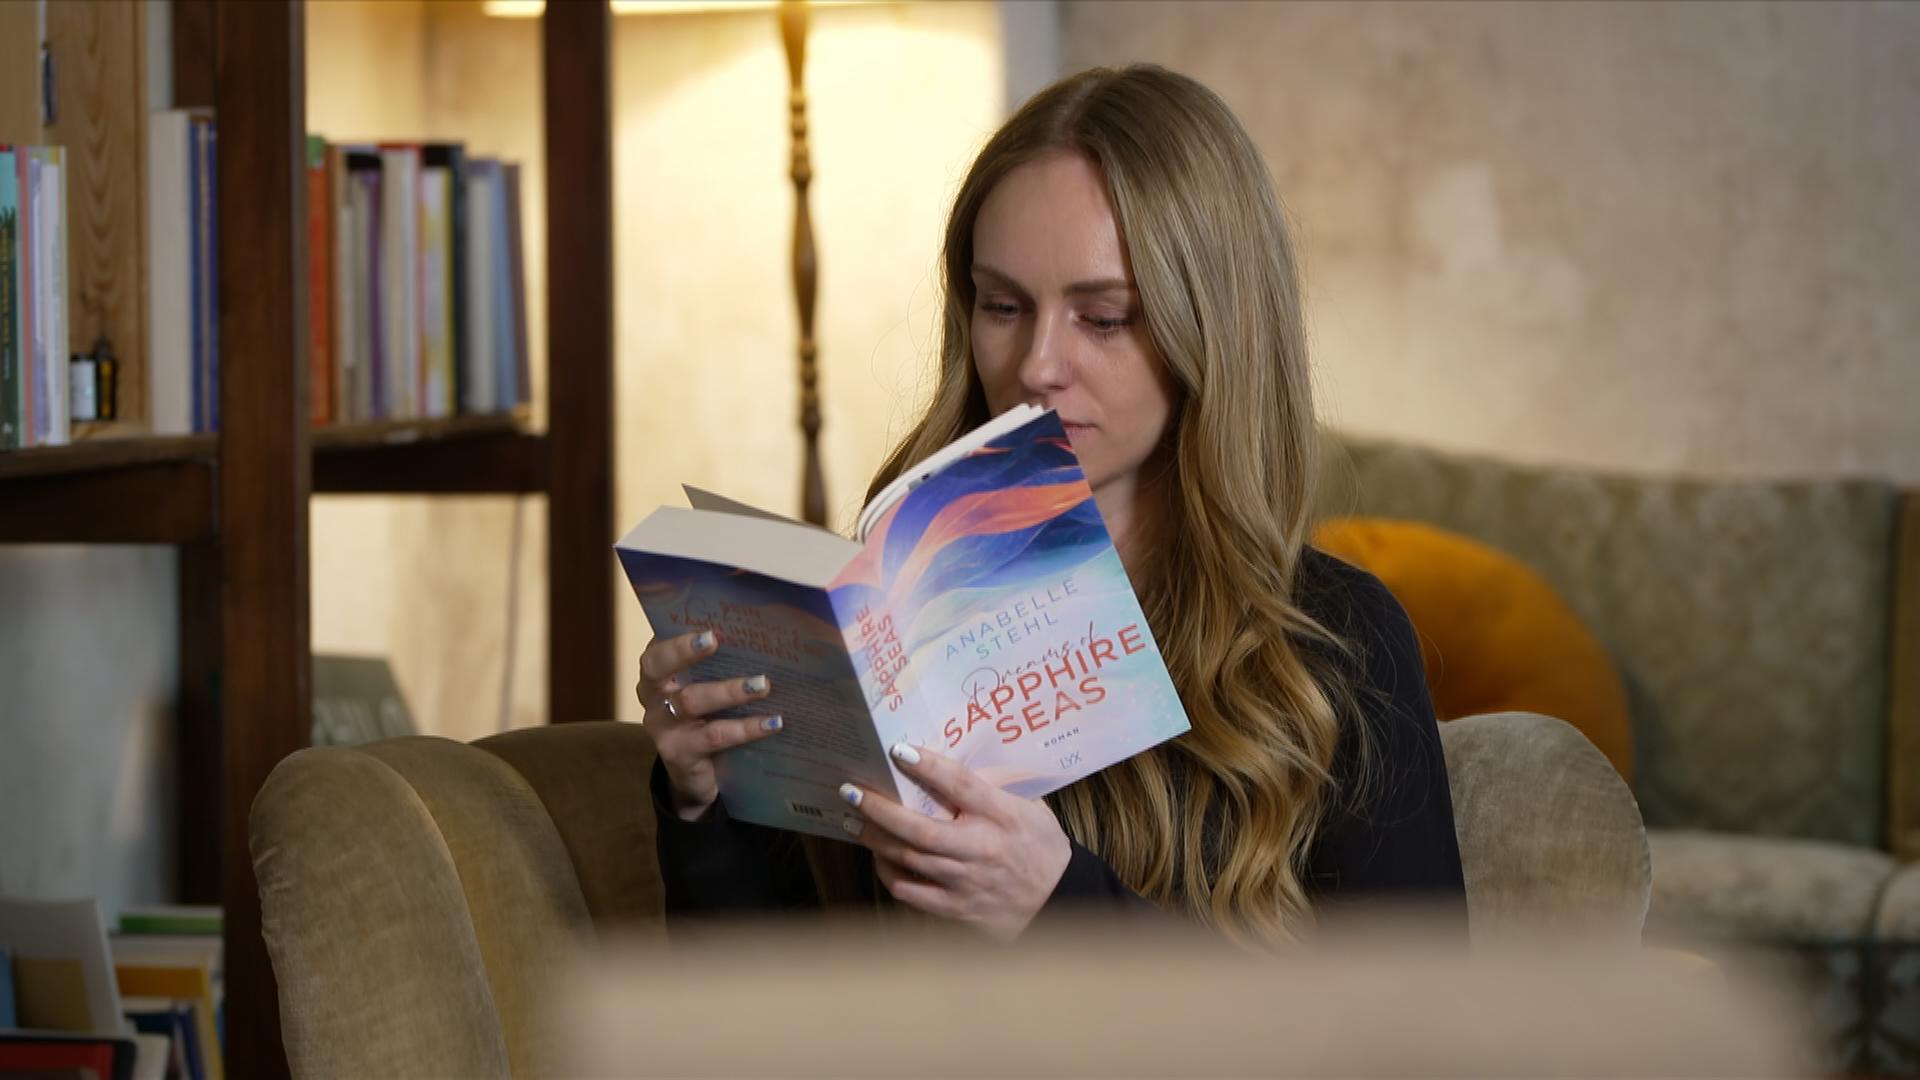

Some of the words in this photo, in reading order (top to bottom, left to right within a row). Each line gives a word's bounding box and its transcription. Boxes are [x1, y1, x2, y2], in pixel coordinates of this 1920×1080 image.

[878, 614, 907, 673] SEAS
[946, 579, 1079, 661] ANABELLE
[976, 612, 1059, 660] STEHL
[856, 603, 903, 712] SAPPHIRE
[944, 623, 1146, 748] SAPPHIRE
[996, 676, 1107, 744] SEAS
[1044, 727, 1080, 748] ROMAN
